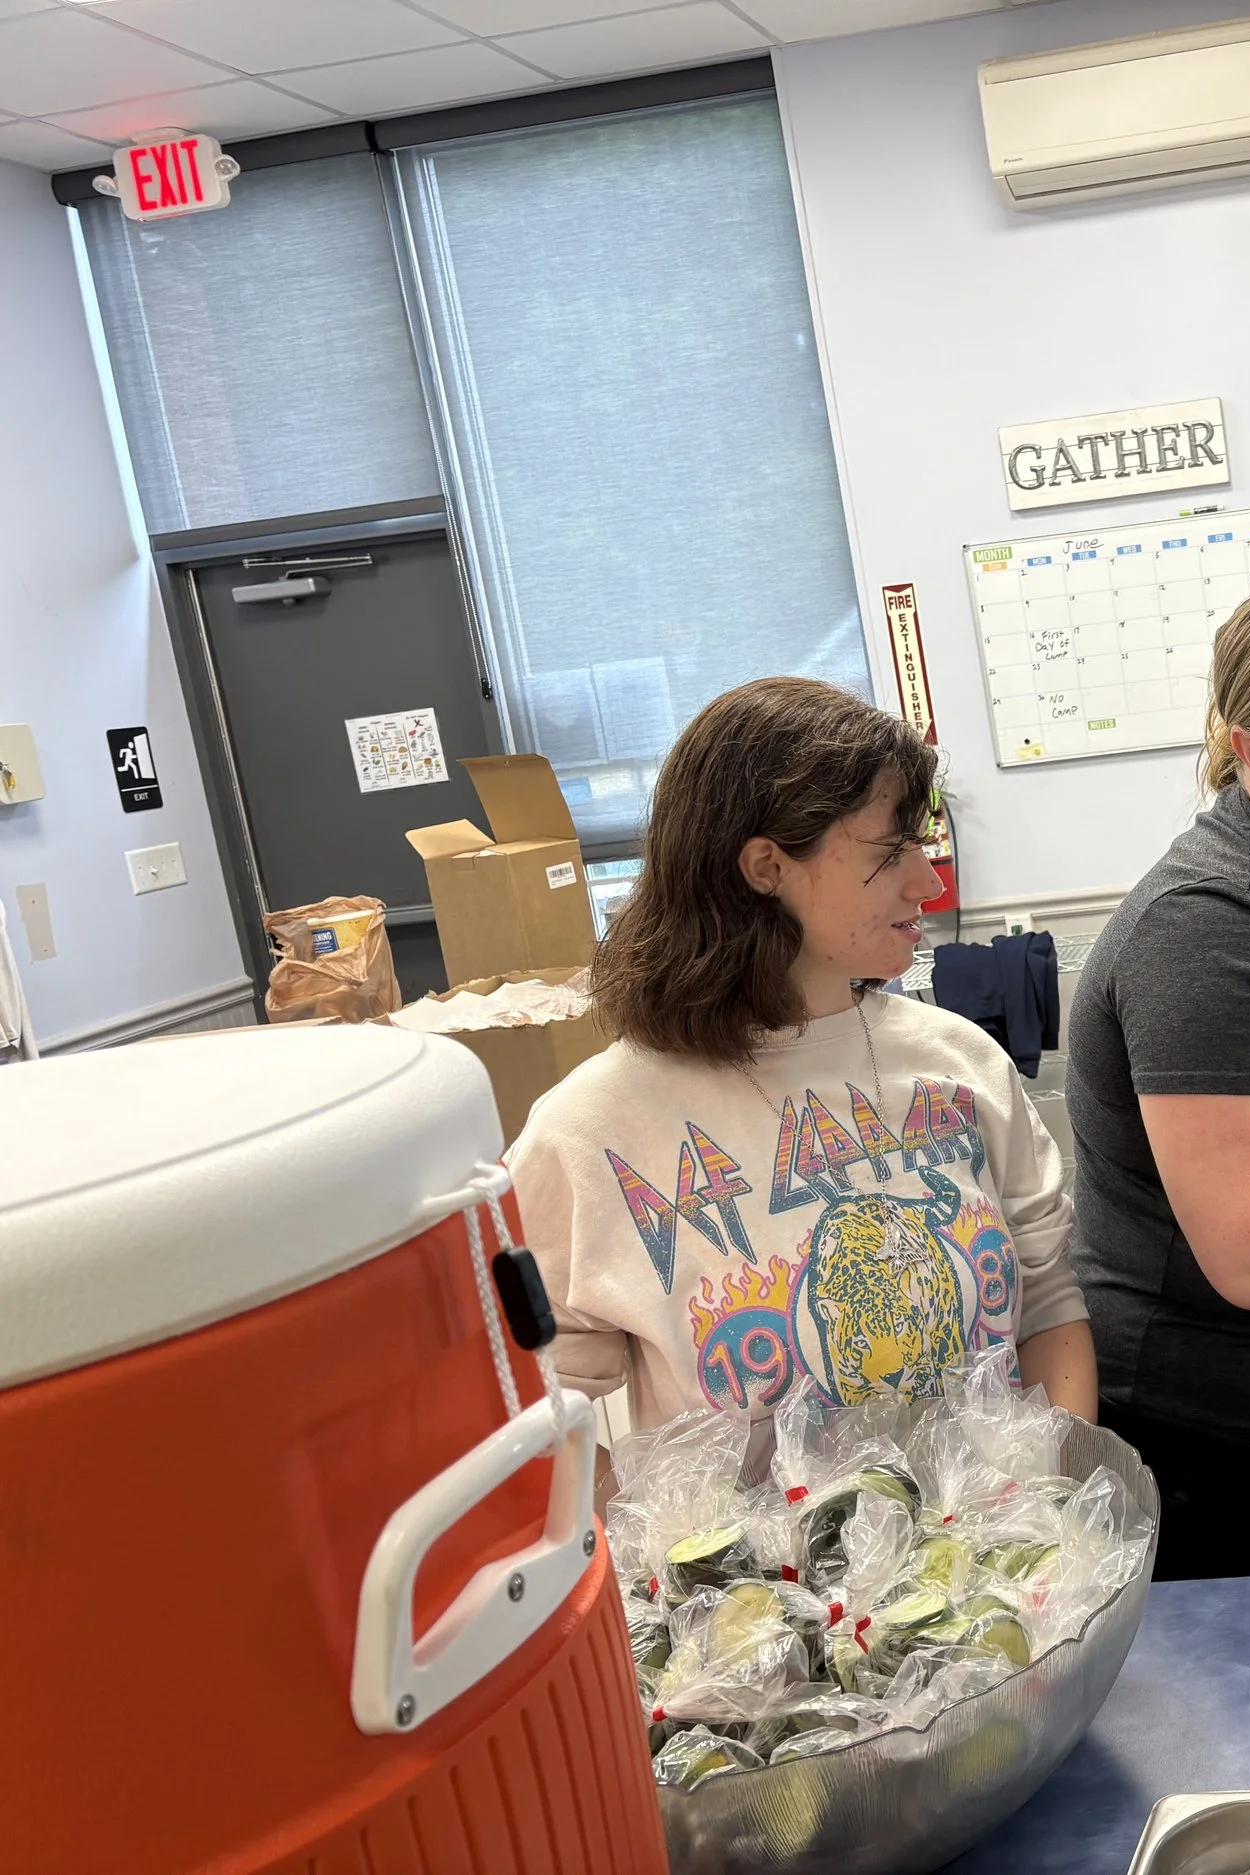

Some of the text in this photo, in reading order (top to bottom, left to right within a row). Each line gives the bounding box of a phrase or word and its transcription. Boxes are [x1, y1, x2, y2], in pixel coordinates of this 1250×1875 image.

[129, 138, 204, 211] EXIT
[1008, 419, 1224, 491] GATHER
[1063, 538, 1104, 554] June
[976, 547, 1011, 562] MONTH
[888, 594, 913, 611] FIRE
[1042, 630, 1064, 642] First
[1060, 638, 1070, 648] of
[1032, 663, 1041, 671] 23
[1121, 652, 1129, 660] 25
[898, 613, 924, 730] EXTINGUISHER
[1089, 719, 1114, 730] NOTES
[134, 792, 149, 801] EXIT
[706, 1326, 793, 1410] 19
